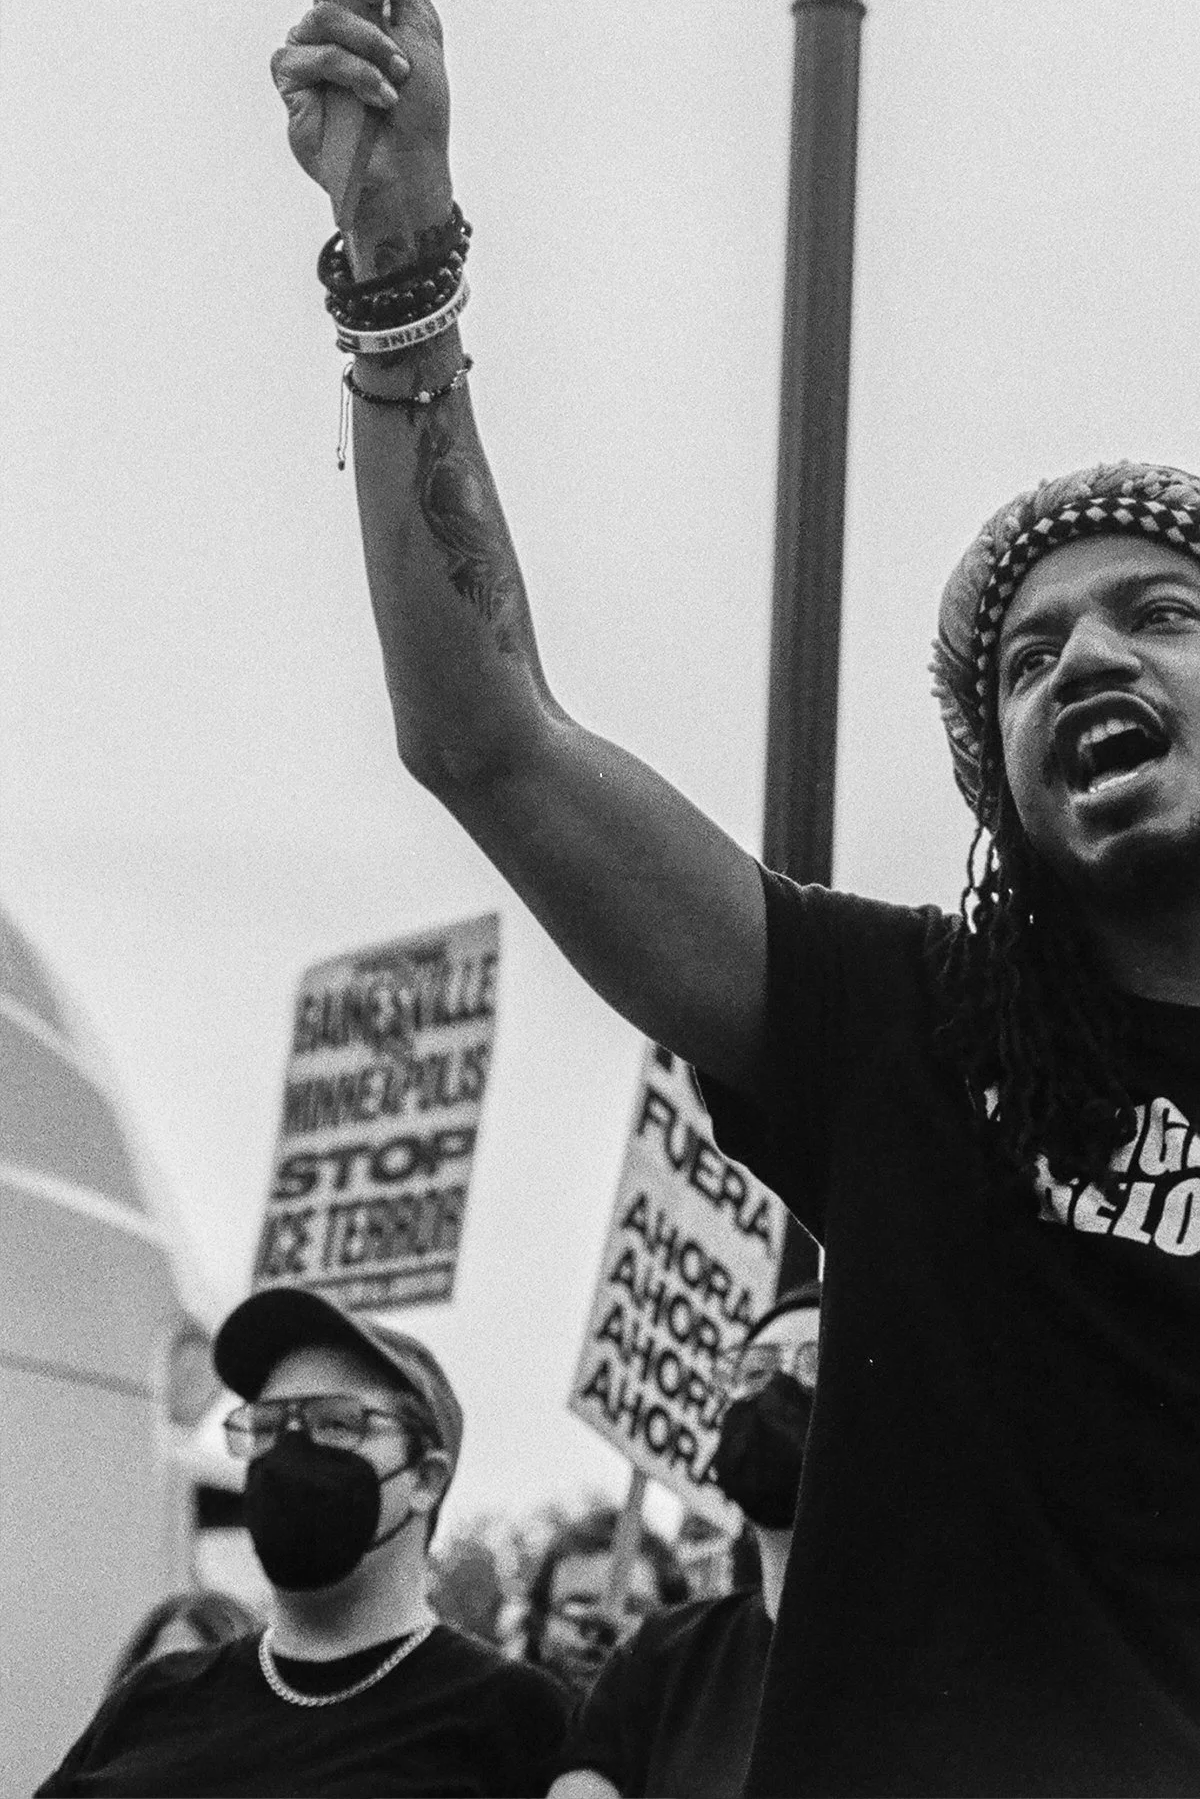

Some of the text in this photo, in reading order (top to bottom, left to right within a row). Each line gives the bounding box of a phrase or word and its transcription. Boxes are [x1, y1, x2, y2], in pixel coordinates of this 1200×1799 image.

[270, 1125, 477, 1200] STOP
[636, 1086, 770, 1244] FUERA
[609, 1248, 719, 1360] AHOR
[623, 1192, 755, 1330] AHORA
